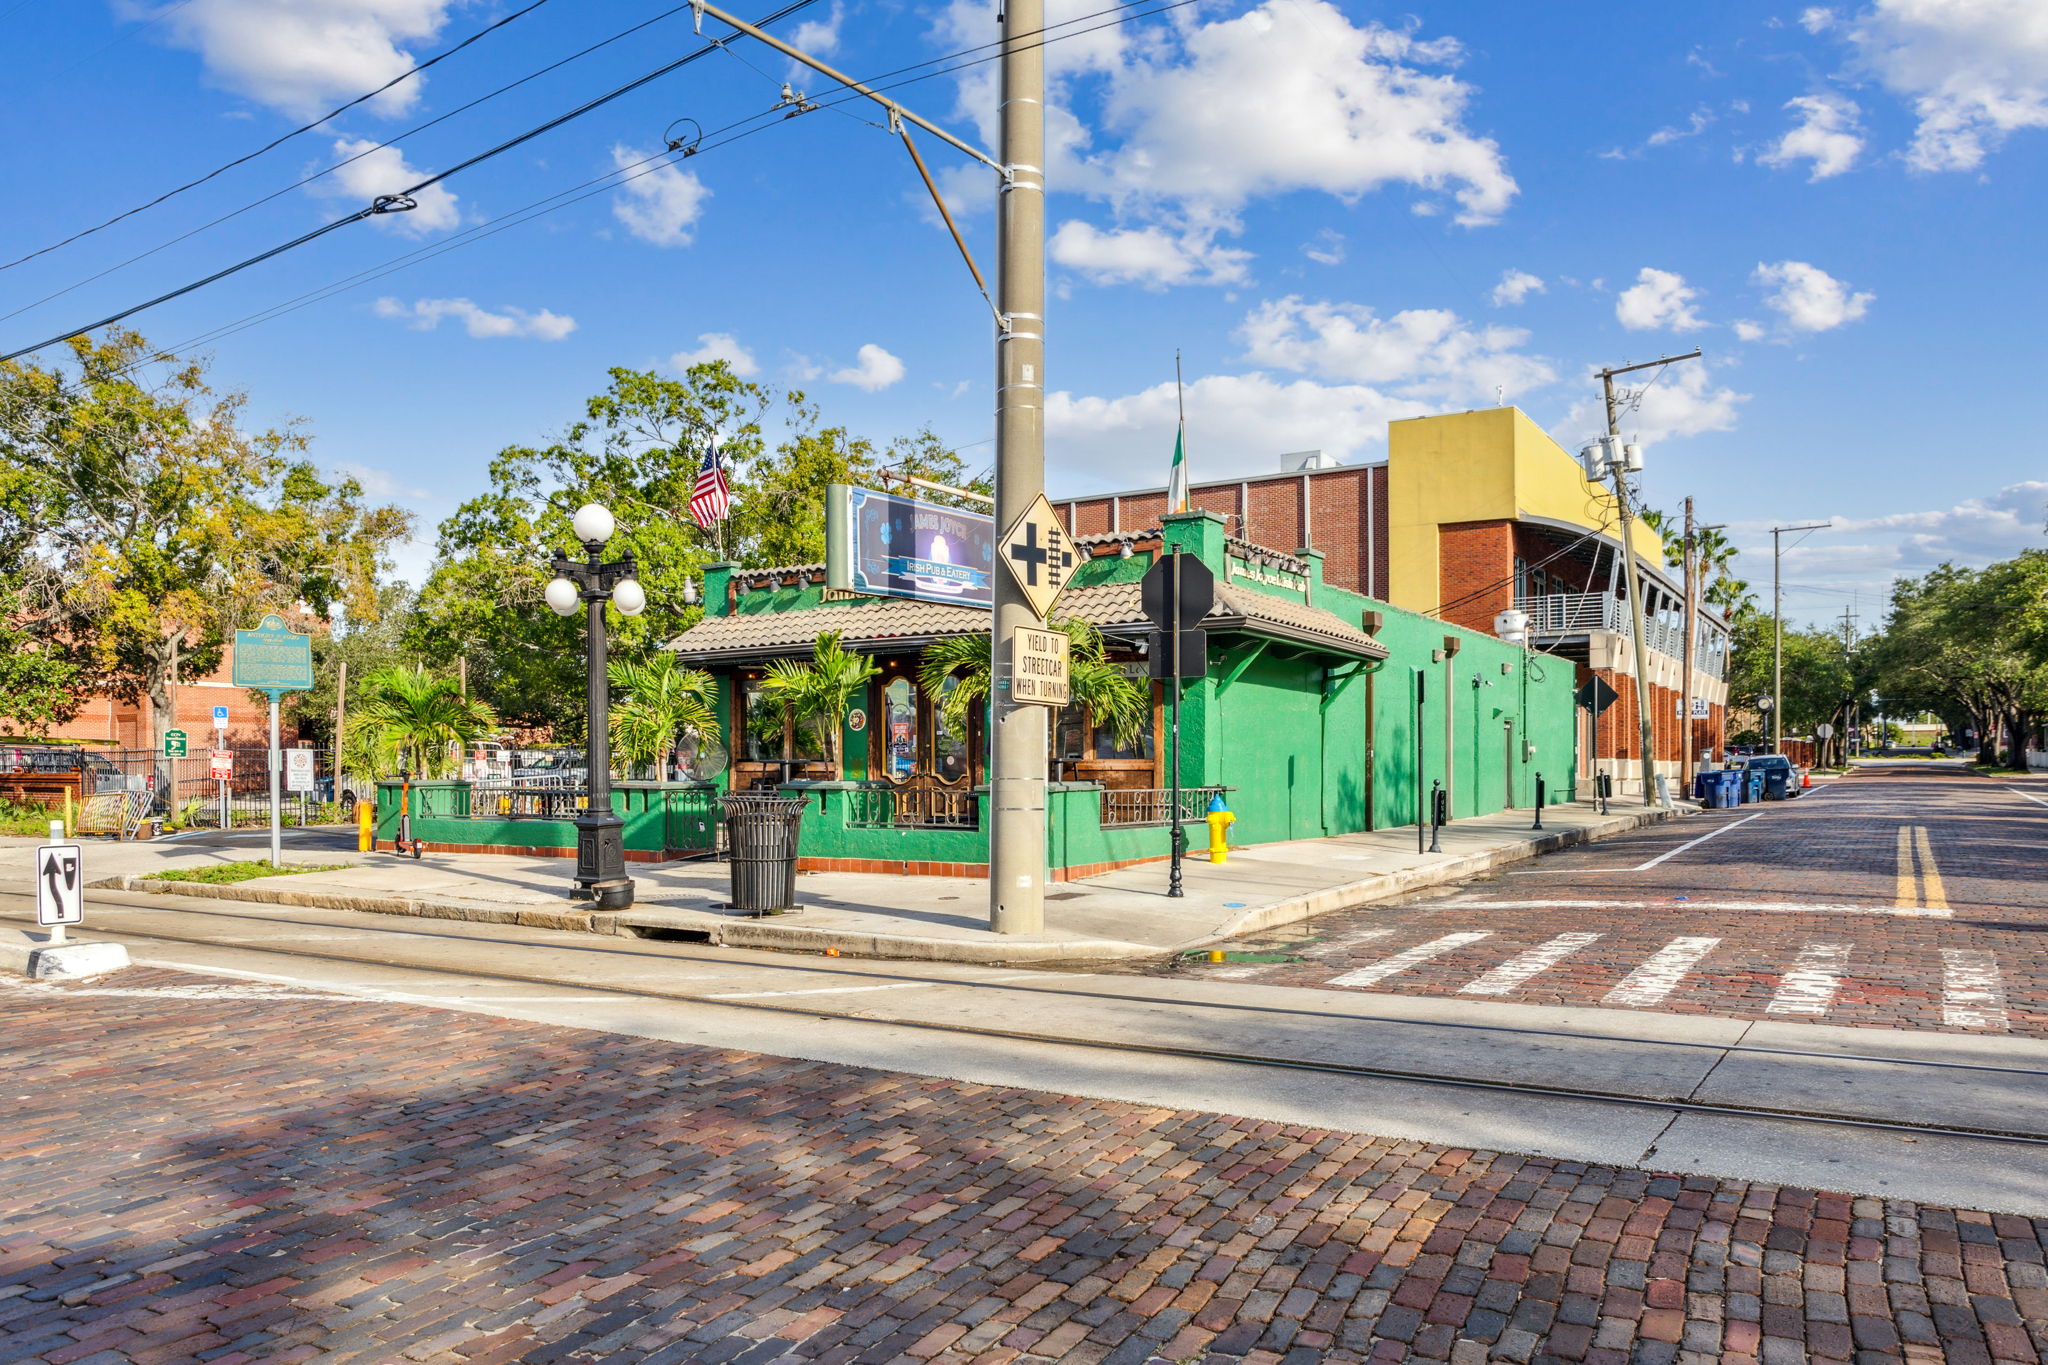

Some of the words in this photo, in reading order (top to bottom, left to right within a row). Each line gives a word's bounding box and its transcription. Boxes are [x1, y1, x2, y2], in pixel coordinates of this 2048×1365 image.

[910, 513, 938, 533] JAMES
[906, 560, 926, 574] IRISH
[926, 563, 941, 577] PUB
[946, 566, 971, 580] EATERY
[1027, 634, 1048, 653] YIELD
[1051, 637, 1060, 655] TO
[1022, 655, 1063, 678] STREETCAR
[1016, 677, 1036, 697] WHEN
[1039, 680, 1068, 699] TURNING
